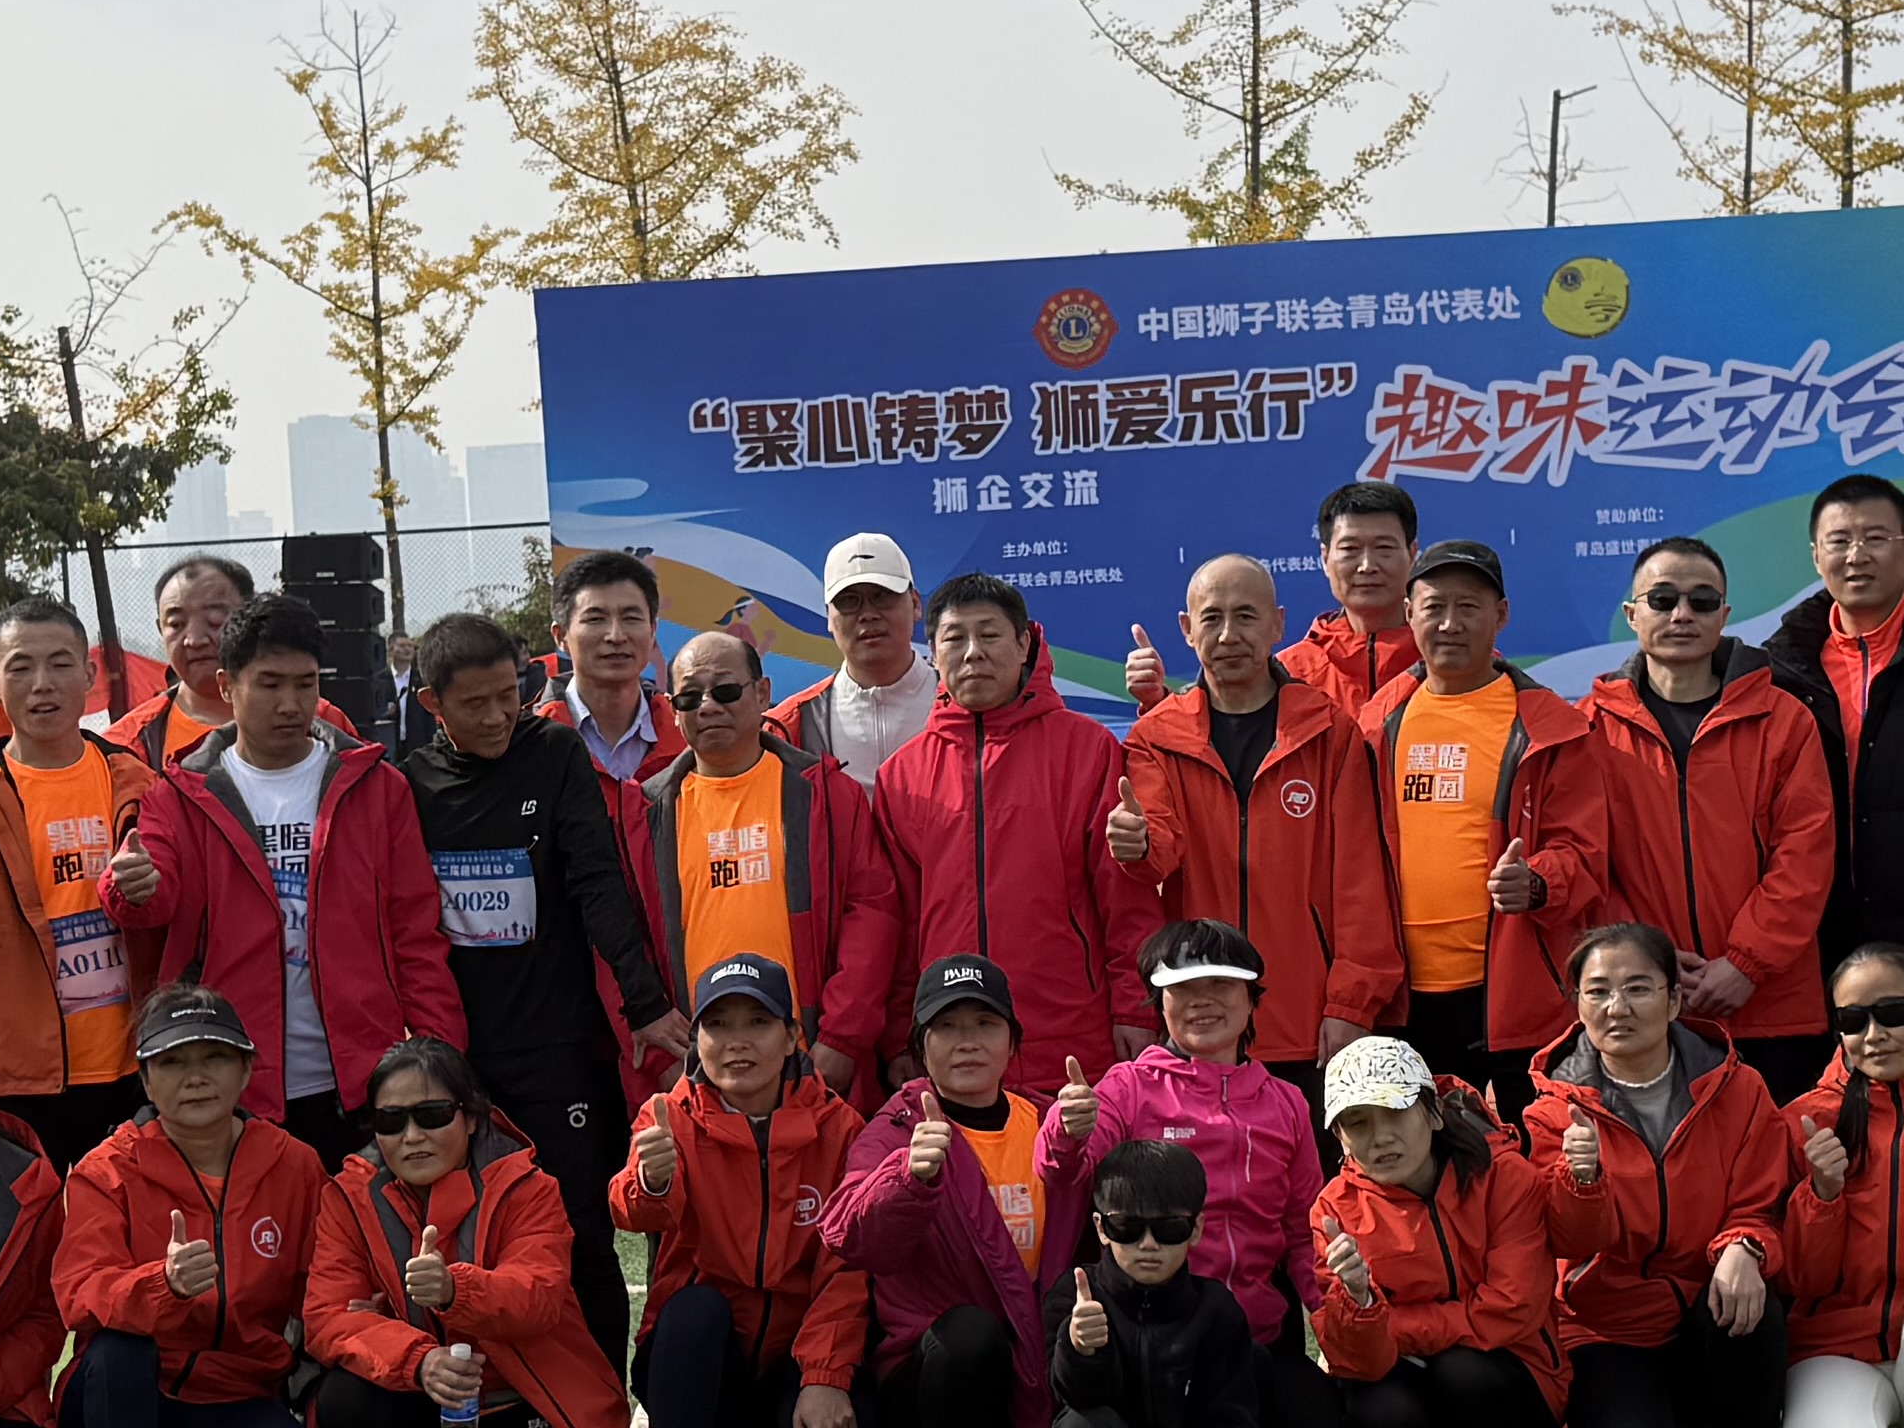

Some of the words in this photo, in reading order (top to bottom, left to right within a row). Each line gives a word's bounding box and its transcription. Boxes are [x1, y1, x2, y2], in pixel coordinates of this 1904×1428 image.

[1137, 286, 1522, 343] 中国狮子联会青岛代表处
[932, 470, 1099, 514] 狮企交流
[1407, 743, 1470, 771] 黑暗
